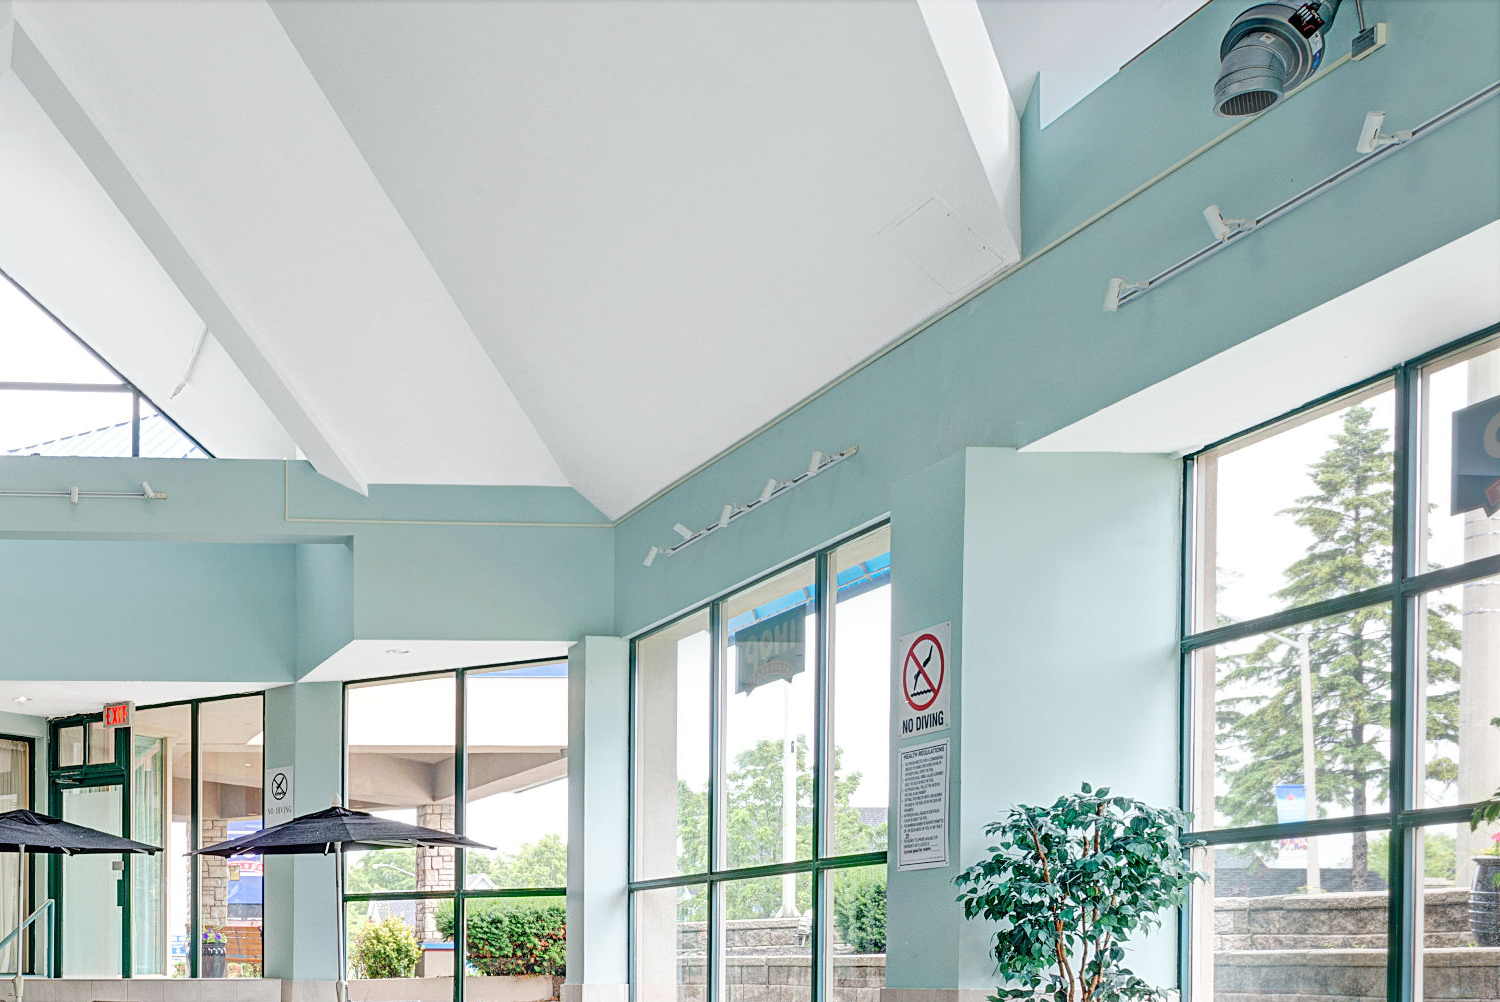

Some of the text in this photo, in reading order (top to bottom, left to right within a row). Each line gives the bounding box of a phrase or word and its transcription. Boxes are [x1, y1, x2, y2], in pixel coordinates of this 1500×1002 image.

[106, 705, 128, 725] EXIT
[902, 711, 944, 734] NO DIVING
[918, 746, 945, 757] REGULATIONS
